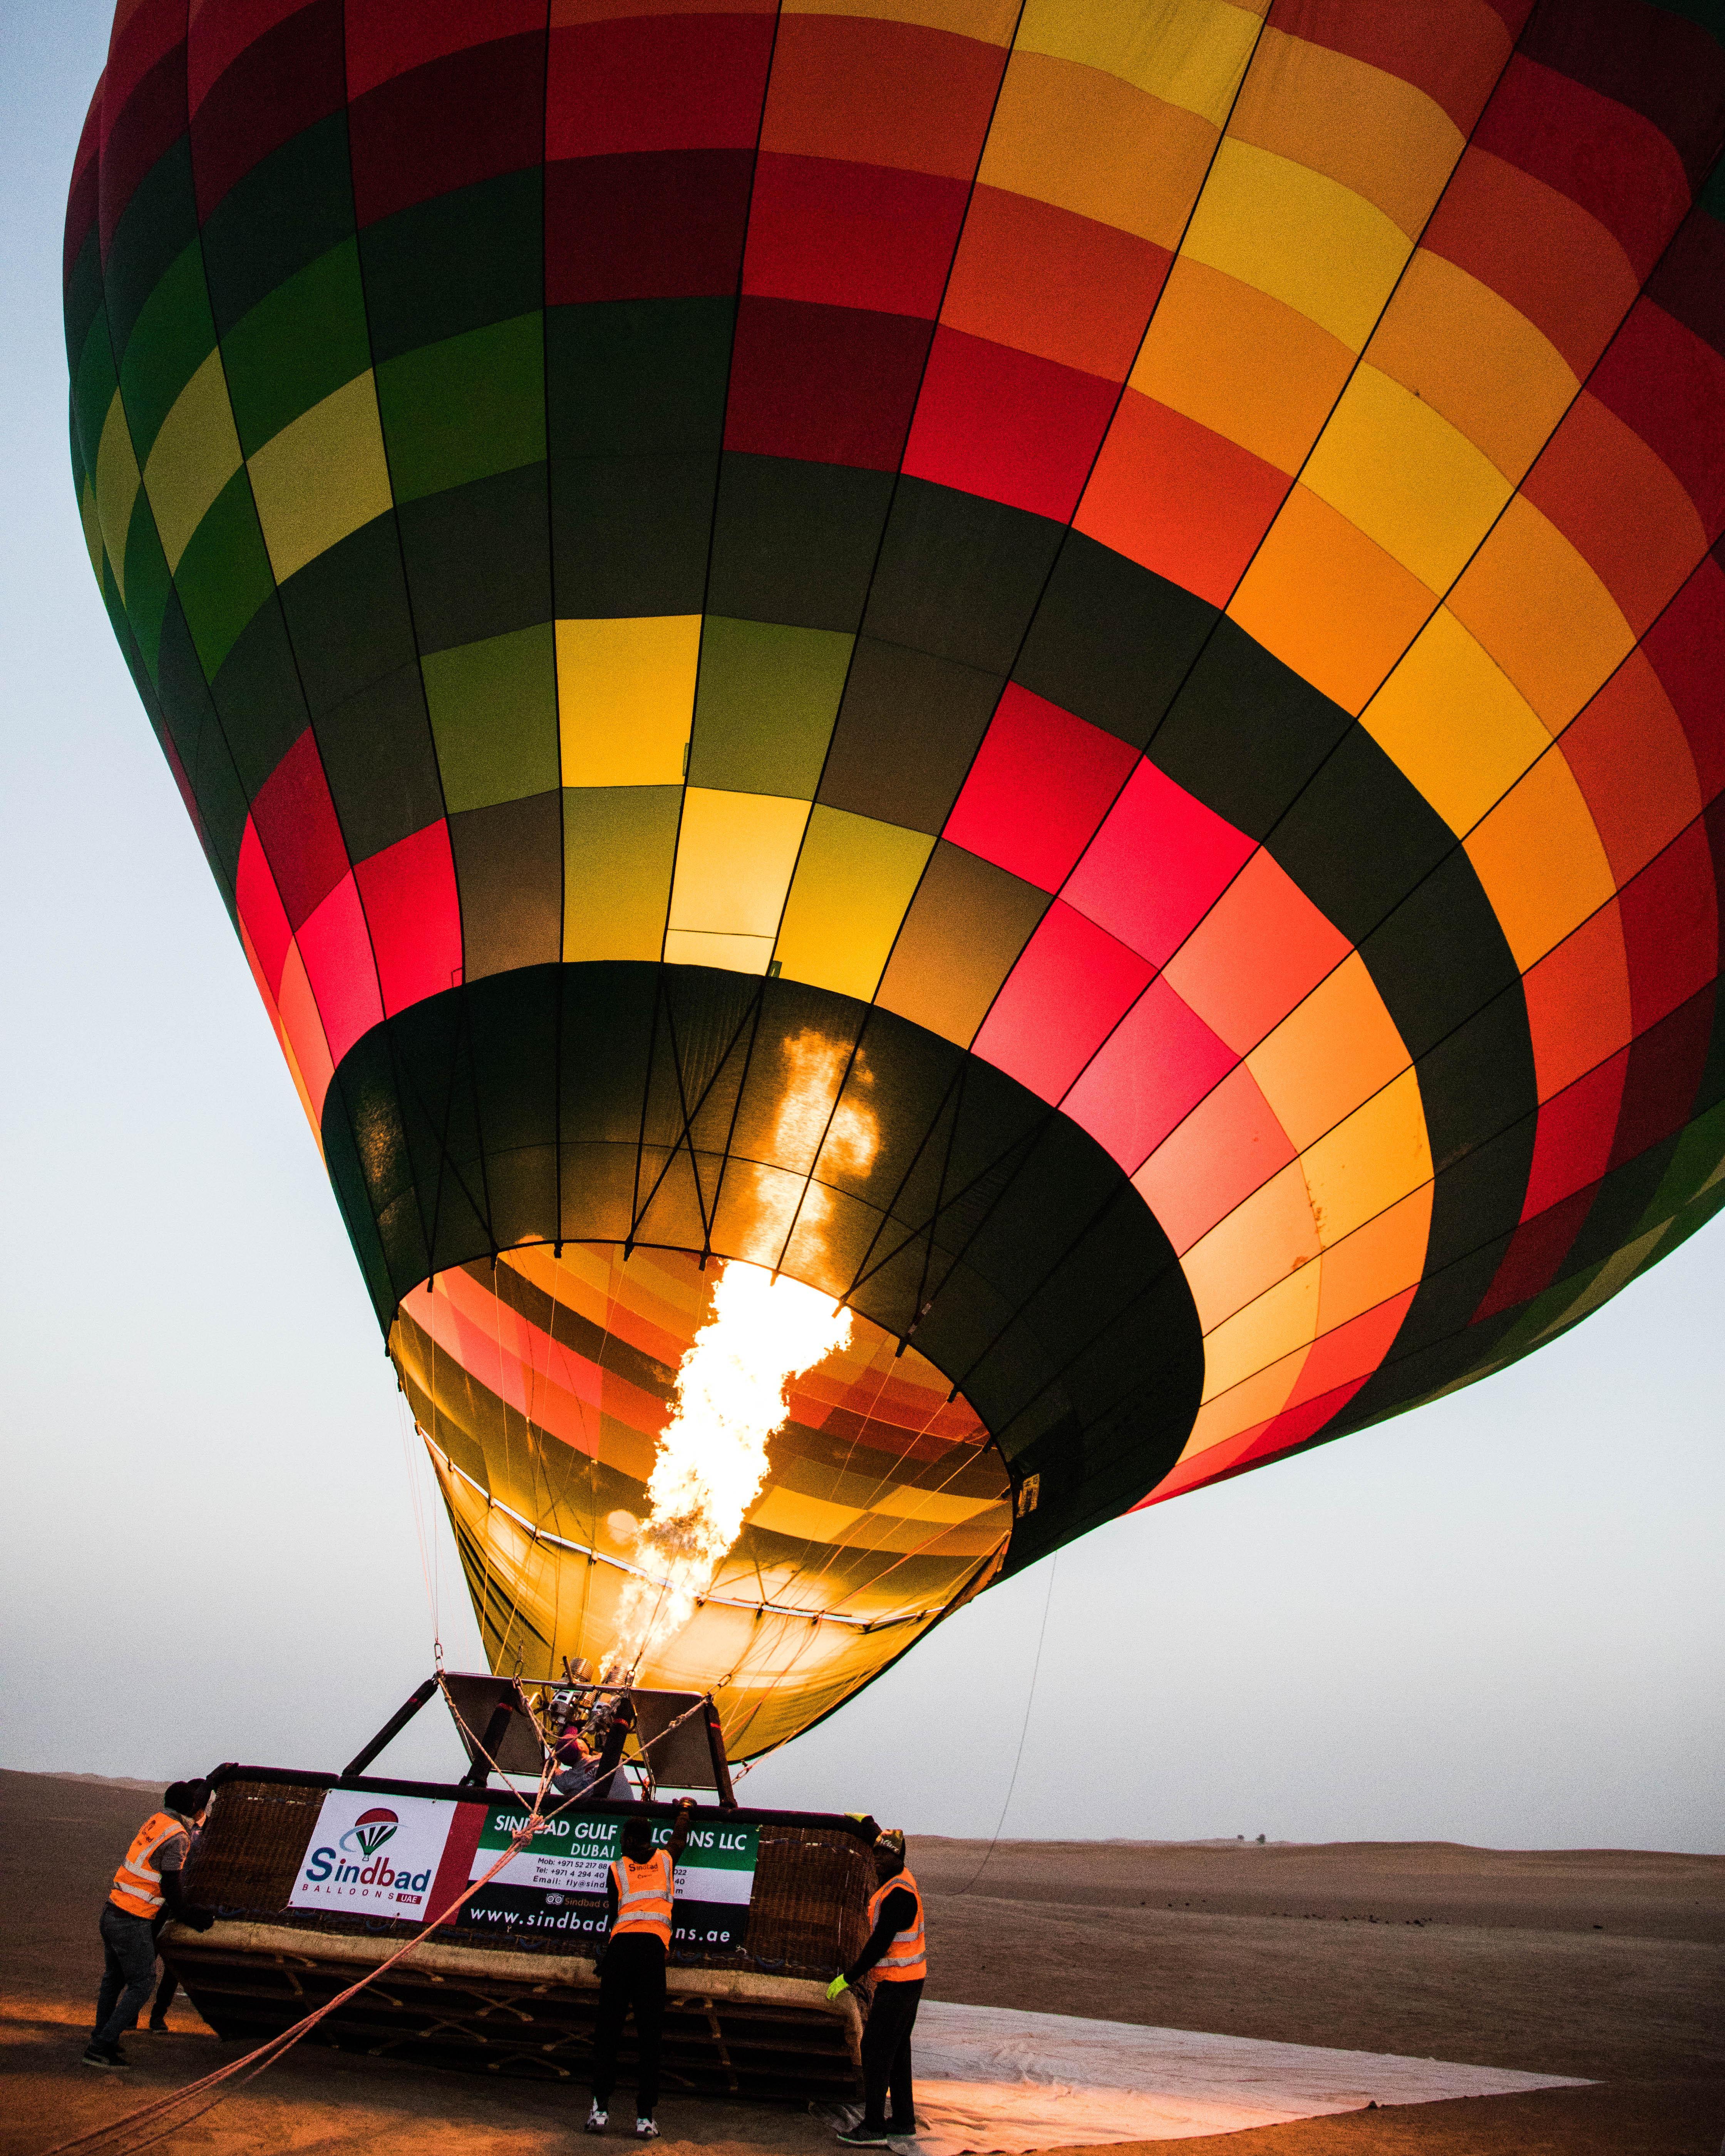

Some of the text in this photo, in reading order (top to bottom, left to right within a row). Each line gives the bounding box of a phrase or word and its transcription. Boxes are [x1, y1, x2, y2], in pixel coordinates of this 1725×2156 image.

[575, 1823, 618, 1840] GULF
[719, 1833, 747, 1850] LLC
[571, 1843, 615, 1858] DUBAI
[306, 1846, 432, 1892] Sindbad
[533, 1875, 561, 1885] Email:
[566, 1879, 605, 1888] fly@sind
[302, 1884, 418, 1903] BALLOONS UAE
